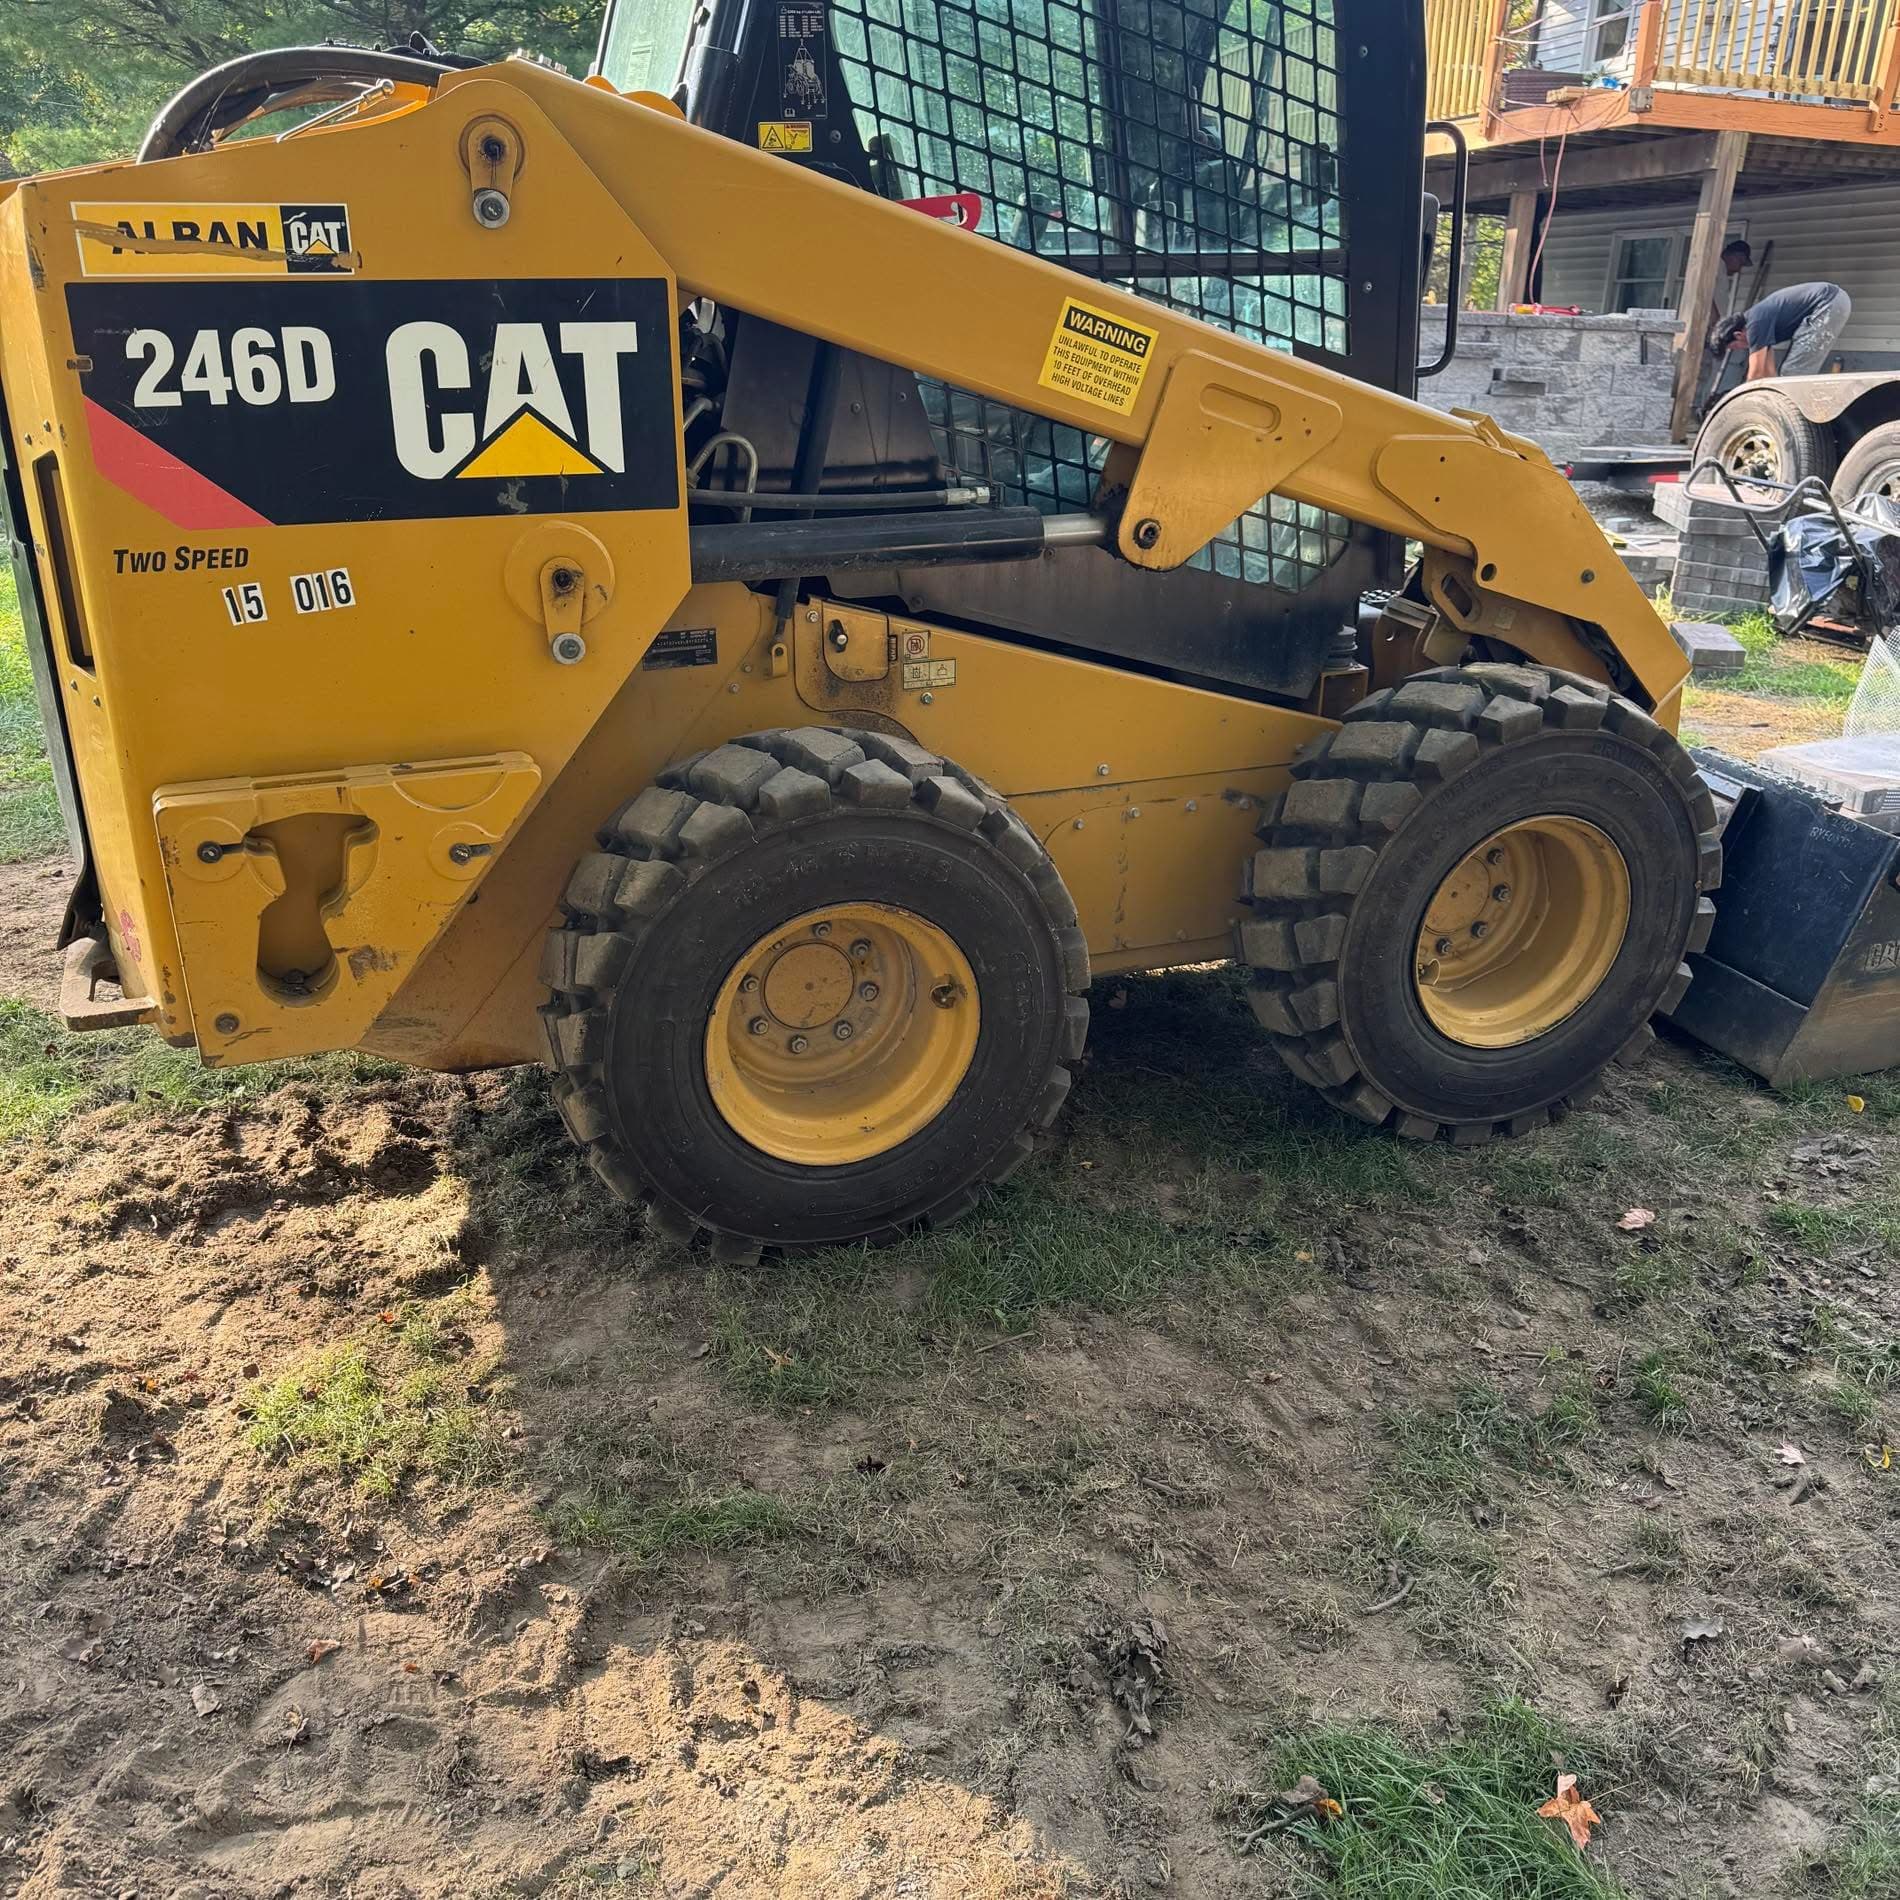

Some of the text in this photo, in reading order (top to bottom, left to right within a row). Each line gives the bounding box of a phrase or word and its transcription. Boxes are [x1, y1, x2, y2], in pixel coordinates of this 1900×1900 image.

[290, 221, 341, 255] CAT
[1069, 310, 1147, 353] WARNING
[1053, 346, 1140, 386] THIS EQUIPMENT WITHIN
[1058, 335, 1142, 373] UNLAWFUL TO OPERATE
[1051, 372, 1125, 406] HIGH VOLTAGE LINES
[1053, 360, 1131, 396] 10 FEET OF OVERHEAD
[124, 321, 638, 479] 246D CAT
[224, 571, 351, 623] 15 016
